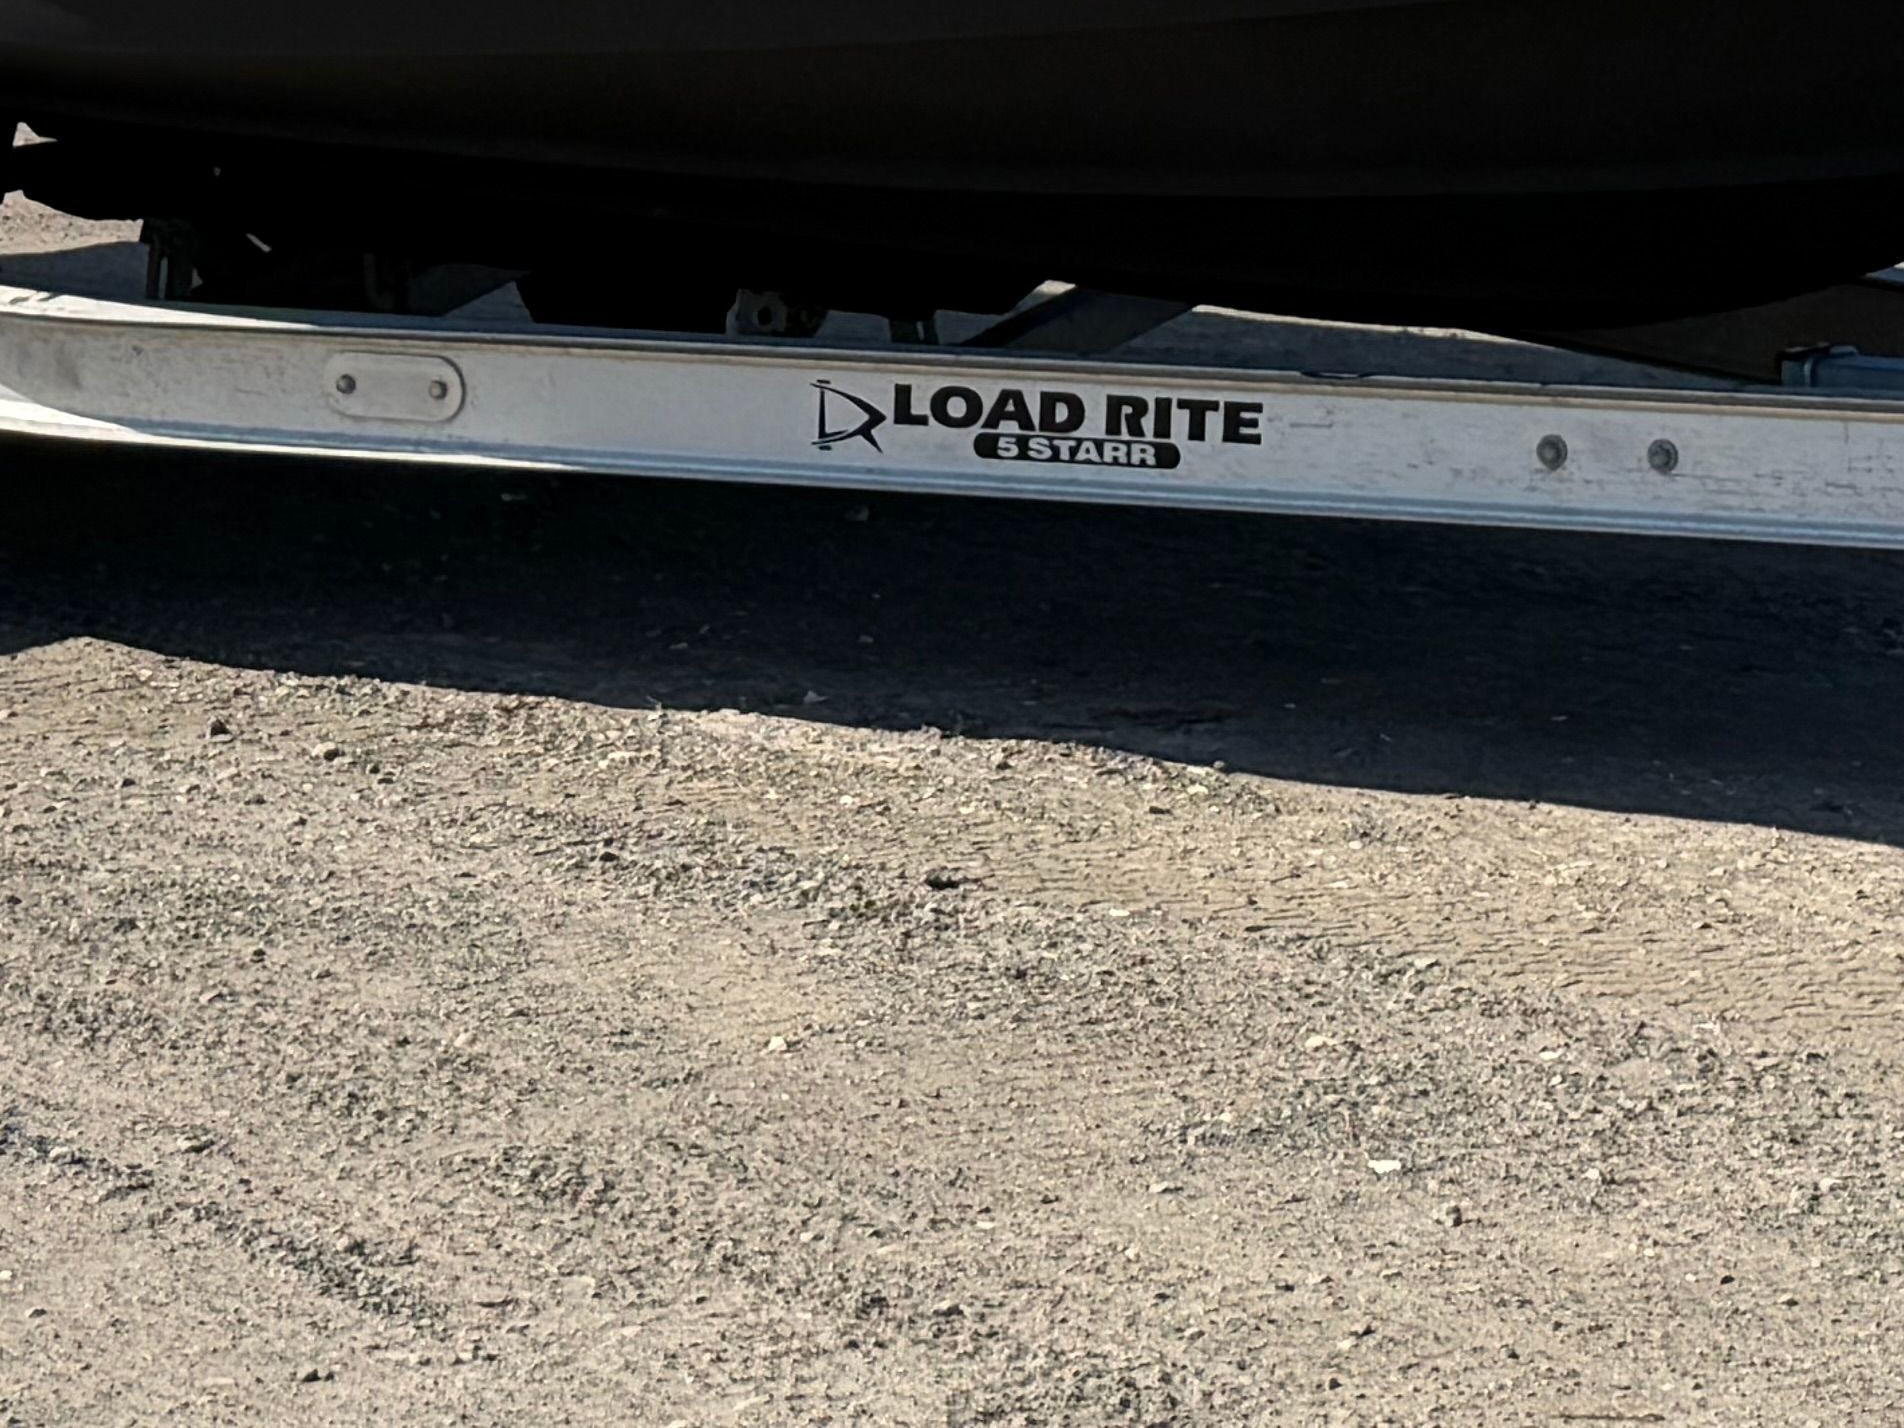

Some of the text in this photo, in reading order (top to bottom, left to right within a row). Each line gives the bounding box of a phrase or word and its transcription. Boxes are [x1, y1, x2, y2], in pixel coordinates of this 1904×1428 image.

[893, 382, 1264, 446] LOAD RITE
[996, 437, 1157, 467] 5 STARR
